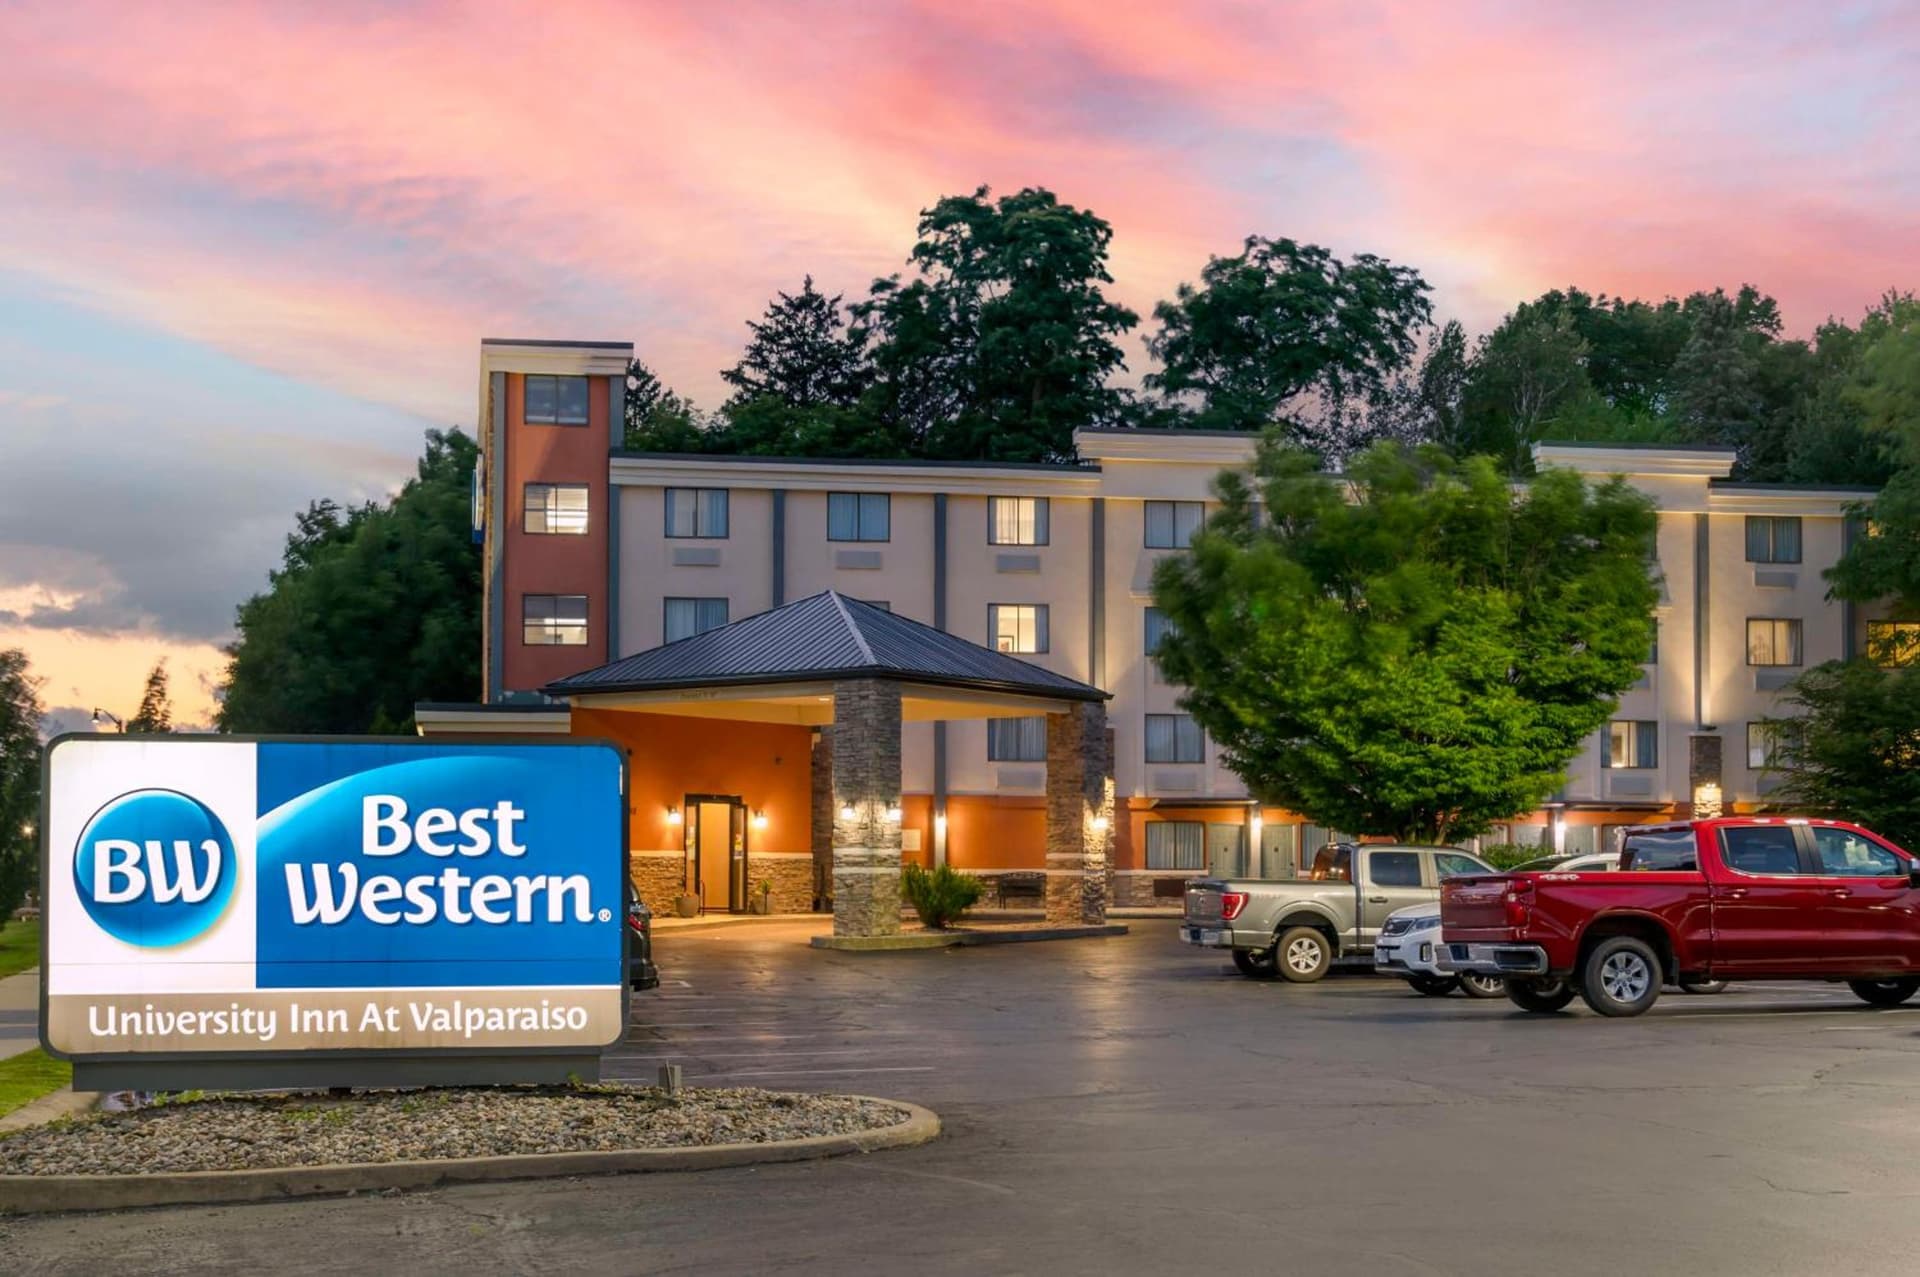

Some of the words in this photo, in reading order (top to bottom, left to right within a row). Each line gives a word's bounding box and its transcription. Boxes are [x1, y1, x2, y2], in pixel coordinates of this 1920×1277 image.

[362, 794, 526, 857] Best
[93, 838, 222, 904] BW
[88, 1002, 277, 1041] University
[290, 1002, 349, 1034] Inn
[358, 1002, 401, 1033] At
[408, 999, 589, 1039] Valparaiso
